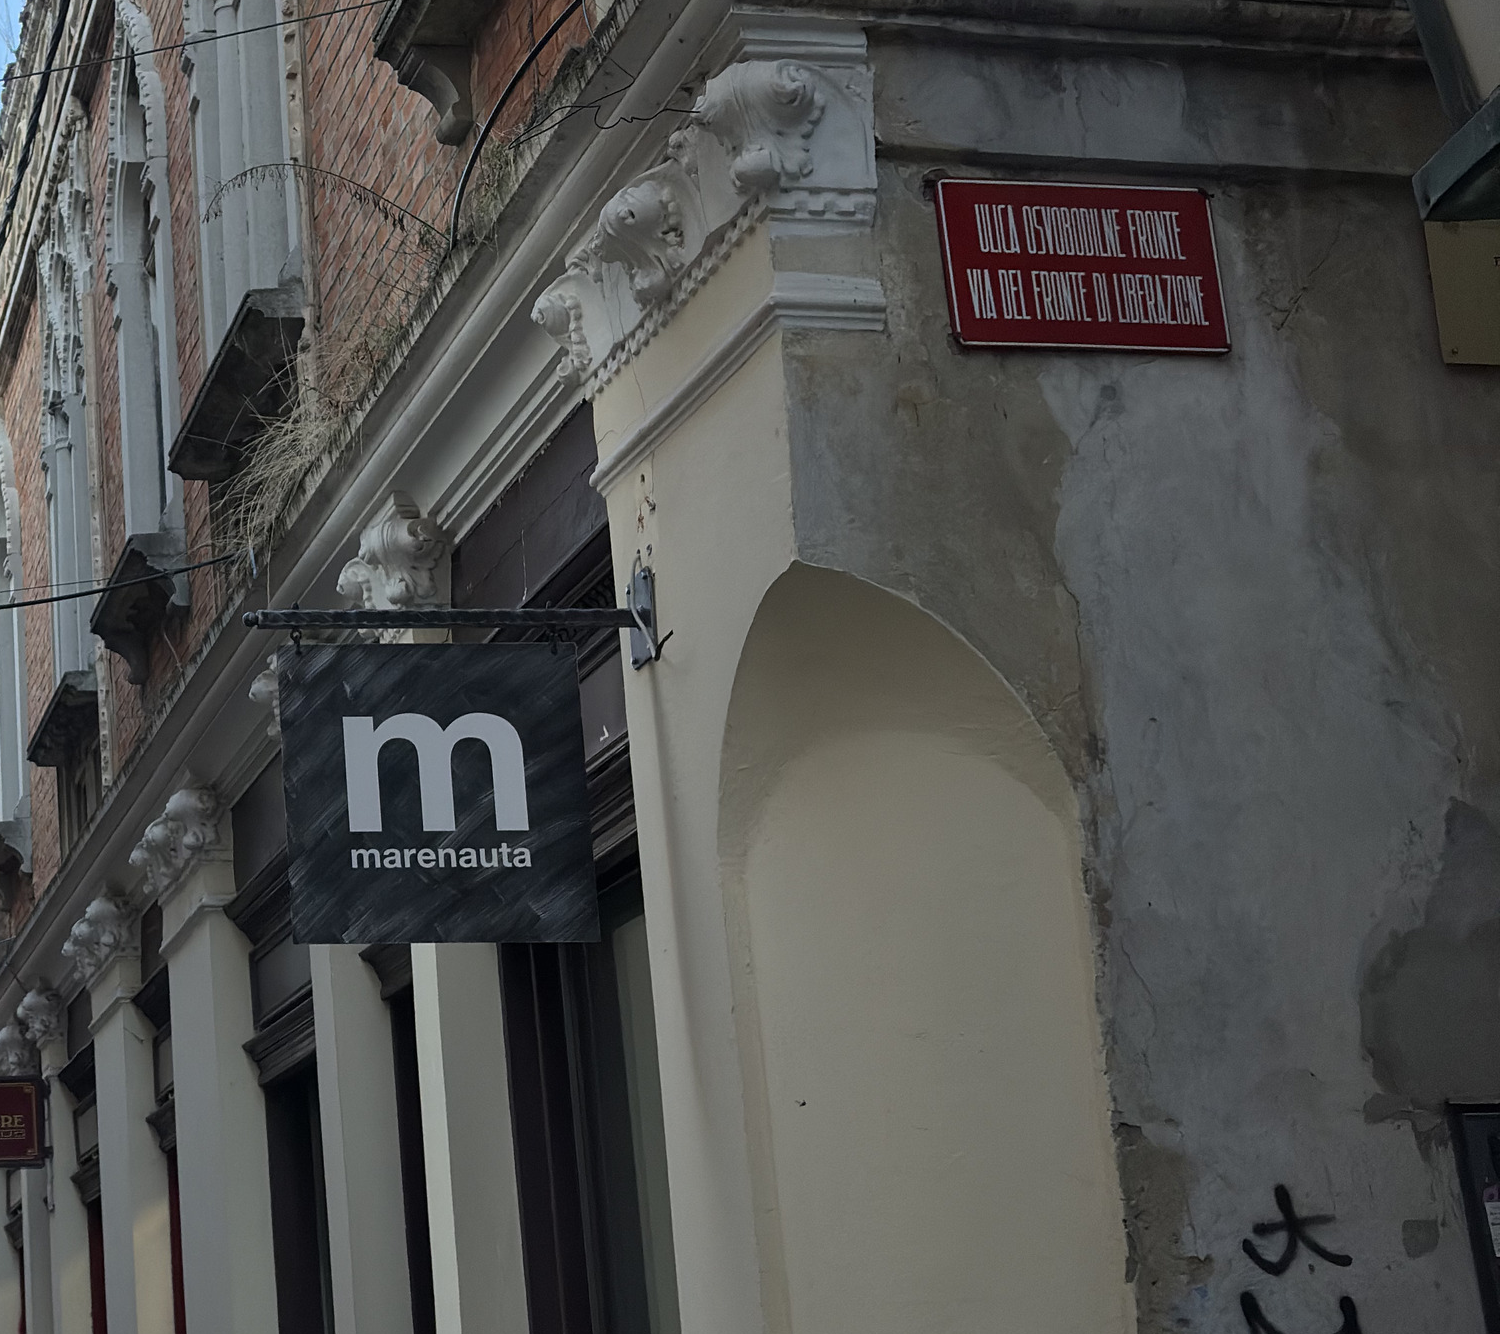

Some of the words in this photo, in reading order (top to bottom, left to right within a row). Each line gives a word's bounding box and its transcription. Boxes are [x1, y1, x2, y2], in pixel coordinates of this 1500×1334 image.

[974, 203, 1021, 254] ULICA
[1022, 205, 1127, 258] OSVOBODILNE
[1127, 209, 1187, 260] FRONTE
[966, 267, 998, 320] VIA
[998, 268, 1032, 320] DEL
[1031, 270, 1092, 322] FRONTE
[1092, 271, 1112, 323] DI
[1113, 272, 1210, 326] LIBERAZIONE
[342, 712, 530, 833] m
[350, 842, 533, 869] marenauta
